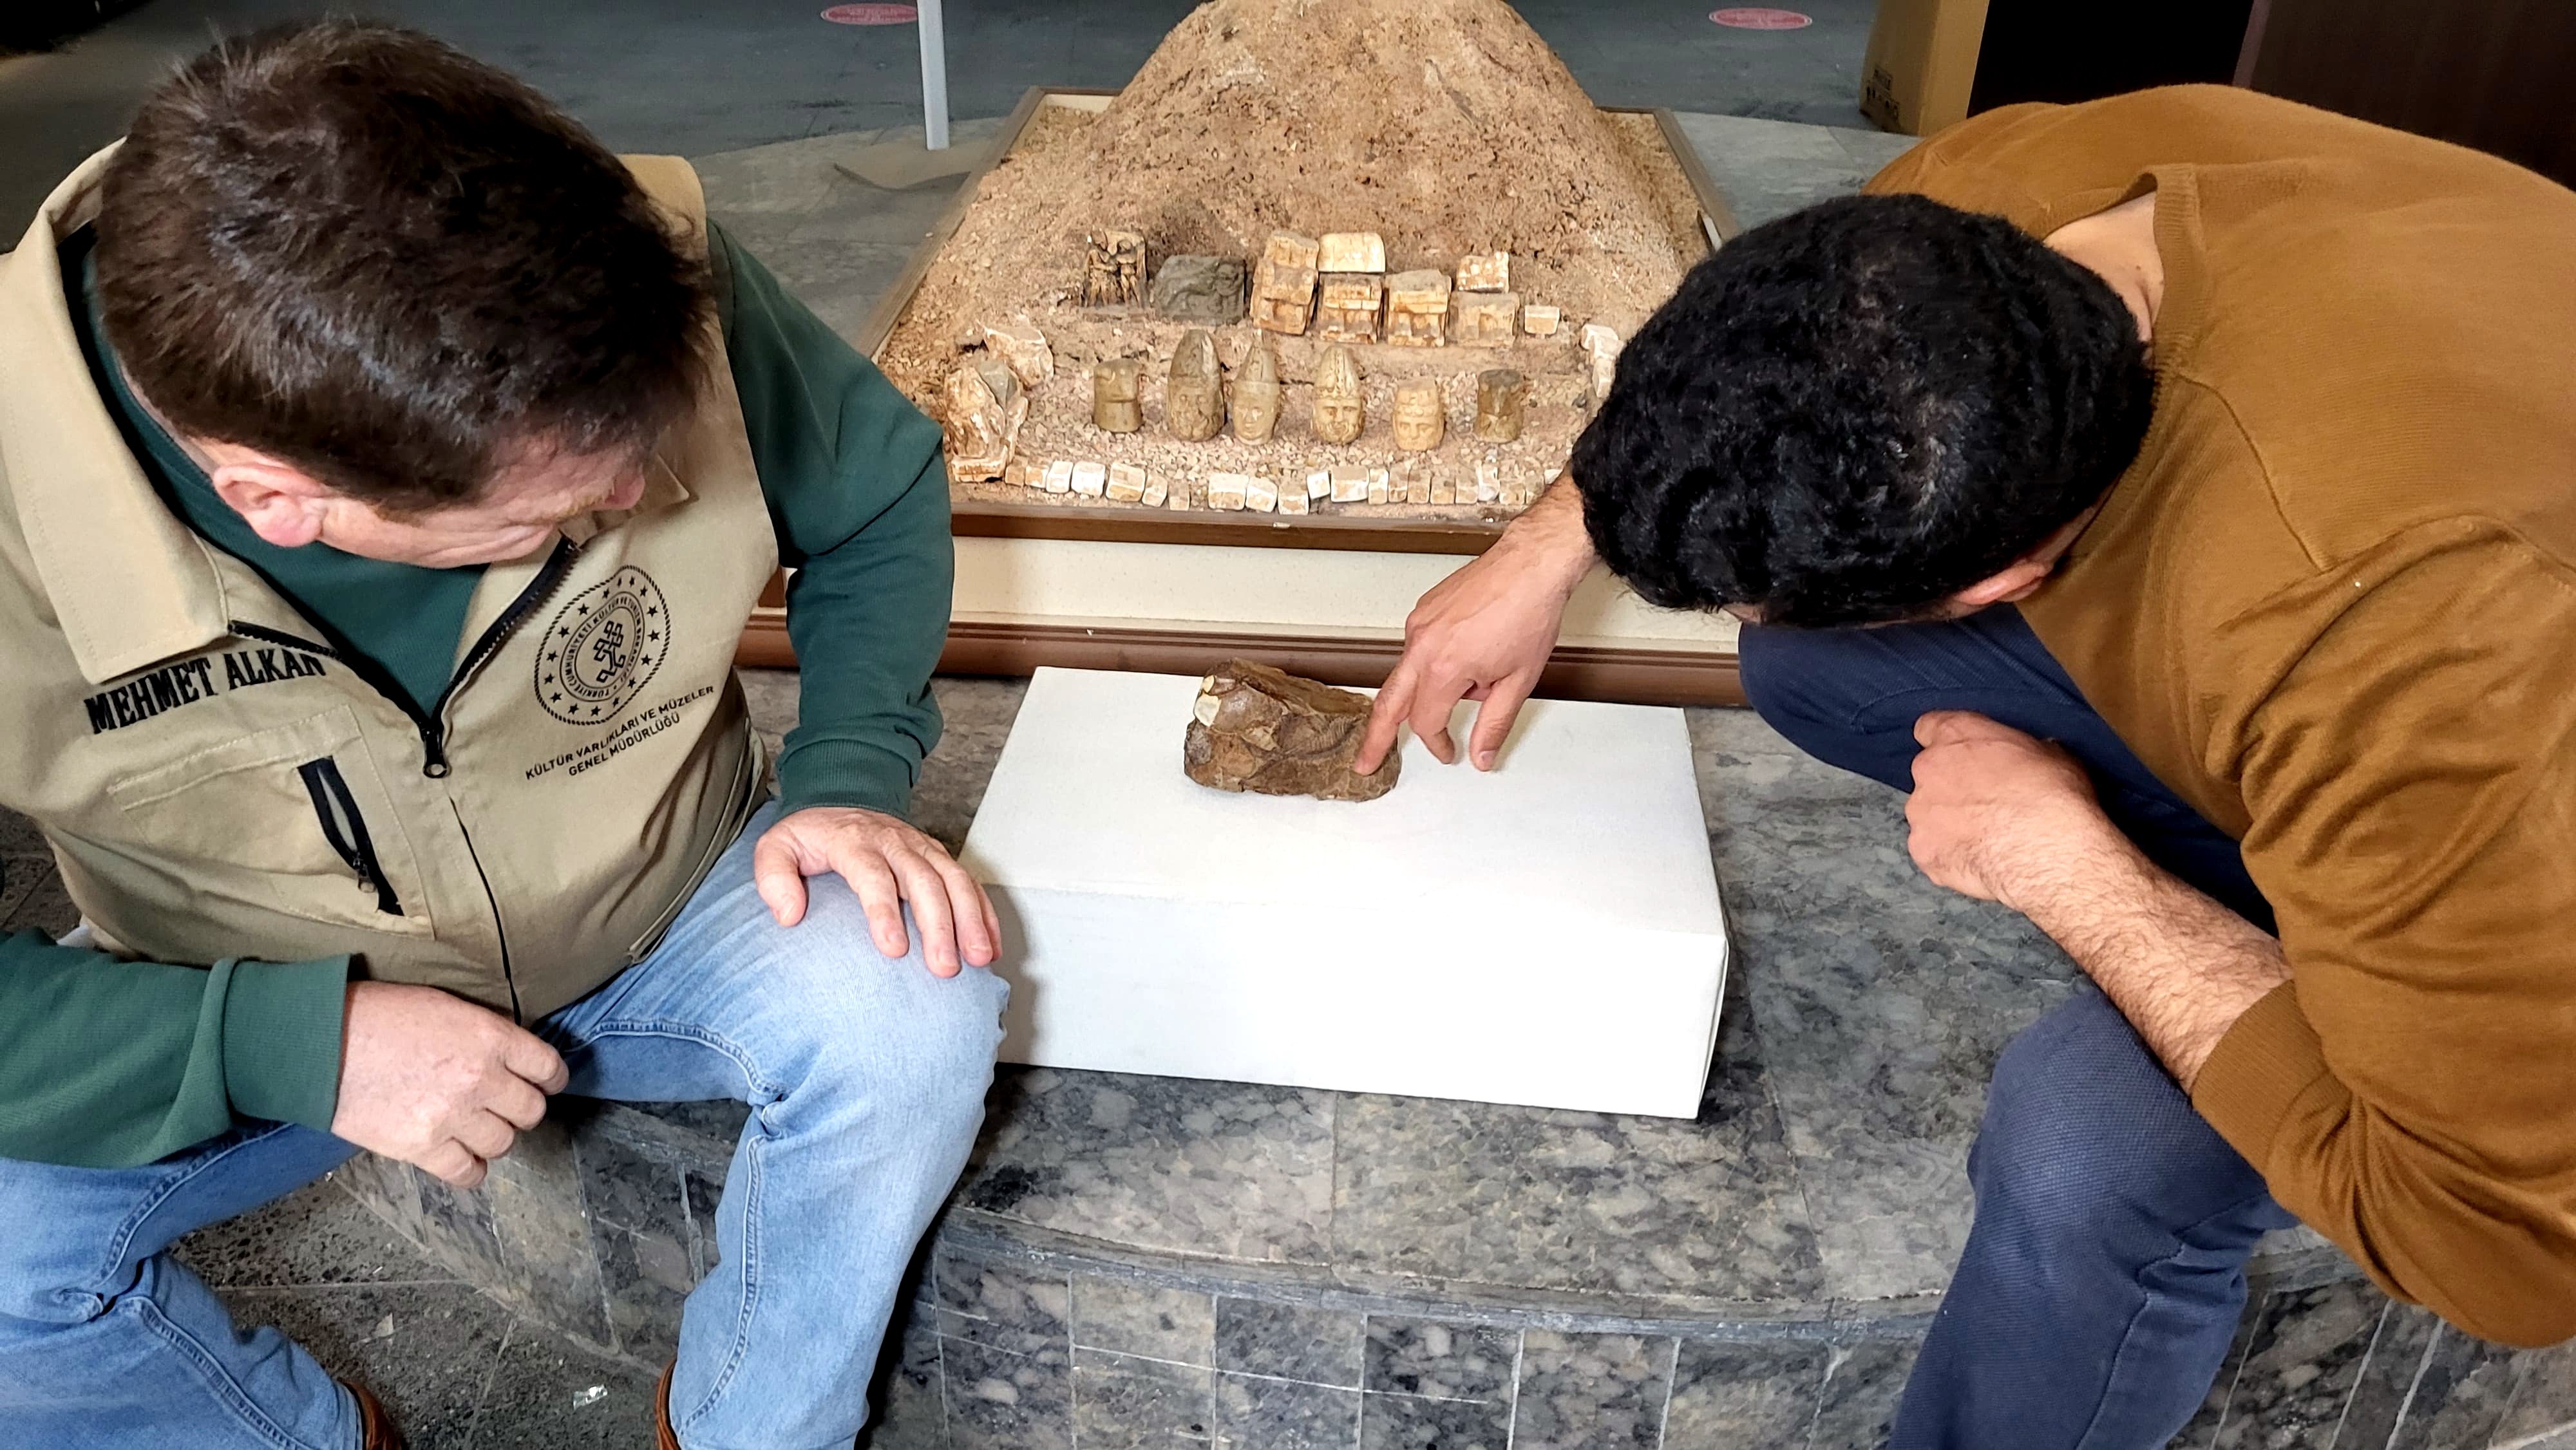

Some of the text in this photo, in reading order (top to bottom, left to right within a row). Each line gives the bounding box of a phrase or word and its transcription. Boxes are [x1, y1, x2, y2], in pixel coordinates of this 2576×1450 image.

[84, 648, 326, 734] MEHMET ALKAN
[526, 685, 714, 780] KÜLTÜR VARLIKLARI VE MÜZELER
[569, 712, 680, 777] GENEL MÜDÜRLÜĞÜ
